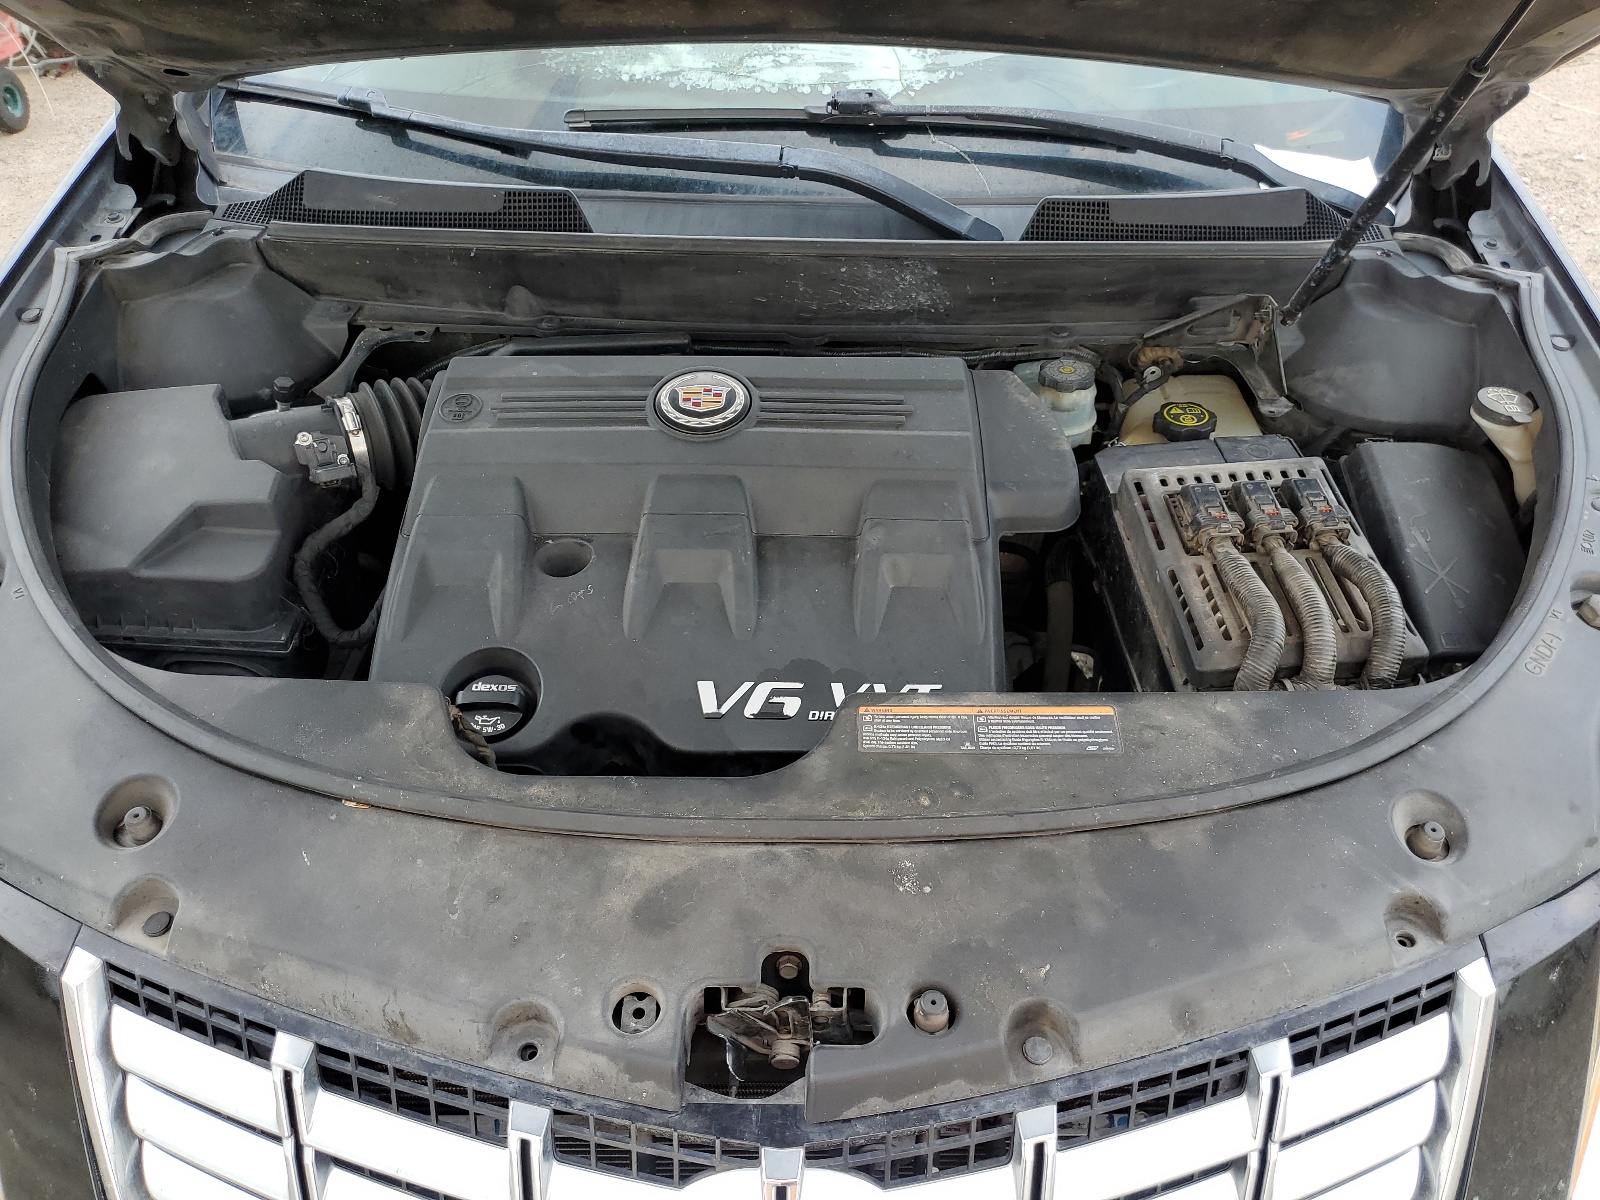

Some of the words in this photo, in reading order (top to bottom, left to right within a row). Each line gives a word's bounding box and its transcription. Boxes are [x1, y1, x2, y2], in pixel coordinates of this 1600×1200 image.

[471, 681, 519, 692] dexos
[696, 680, 805, 719] V6
[482, 723, 506, 733] 5W-30
